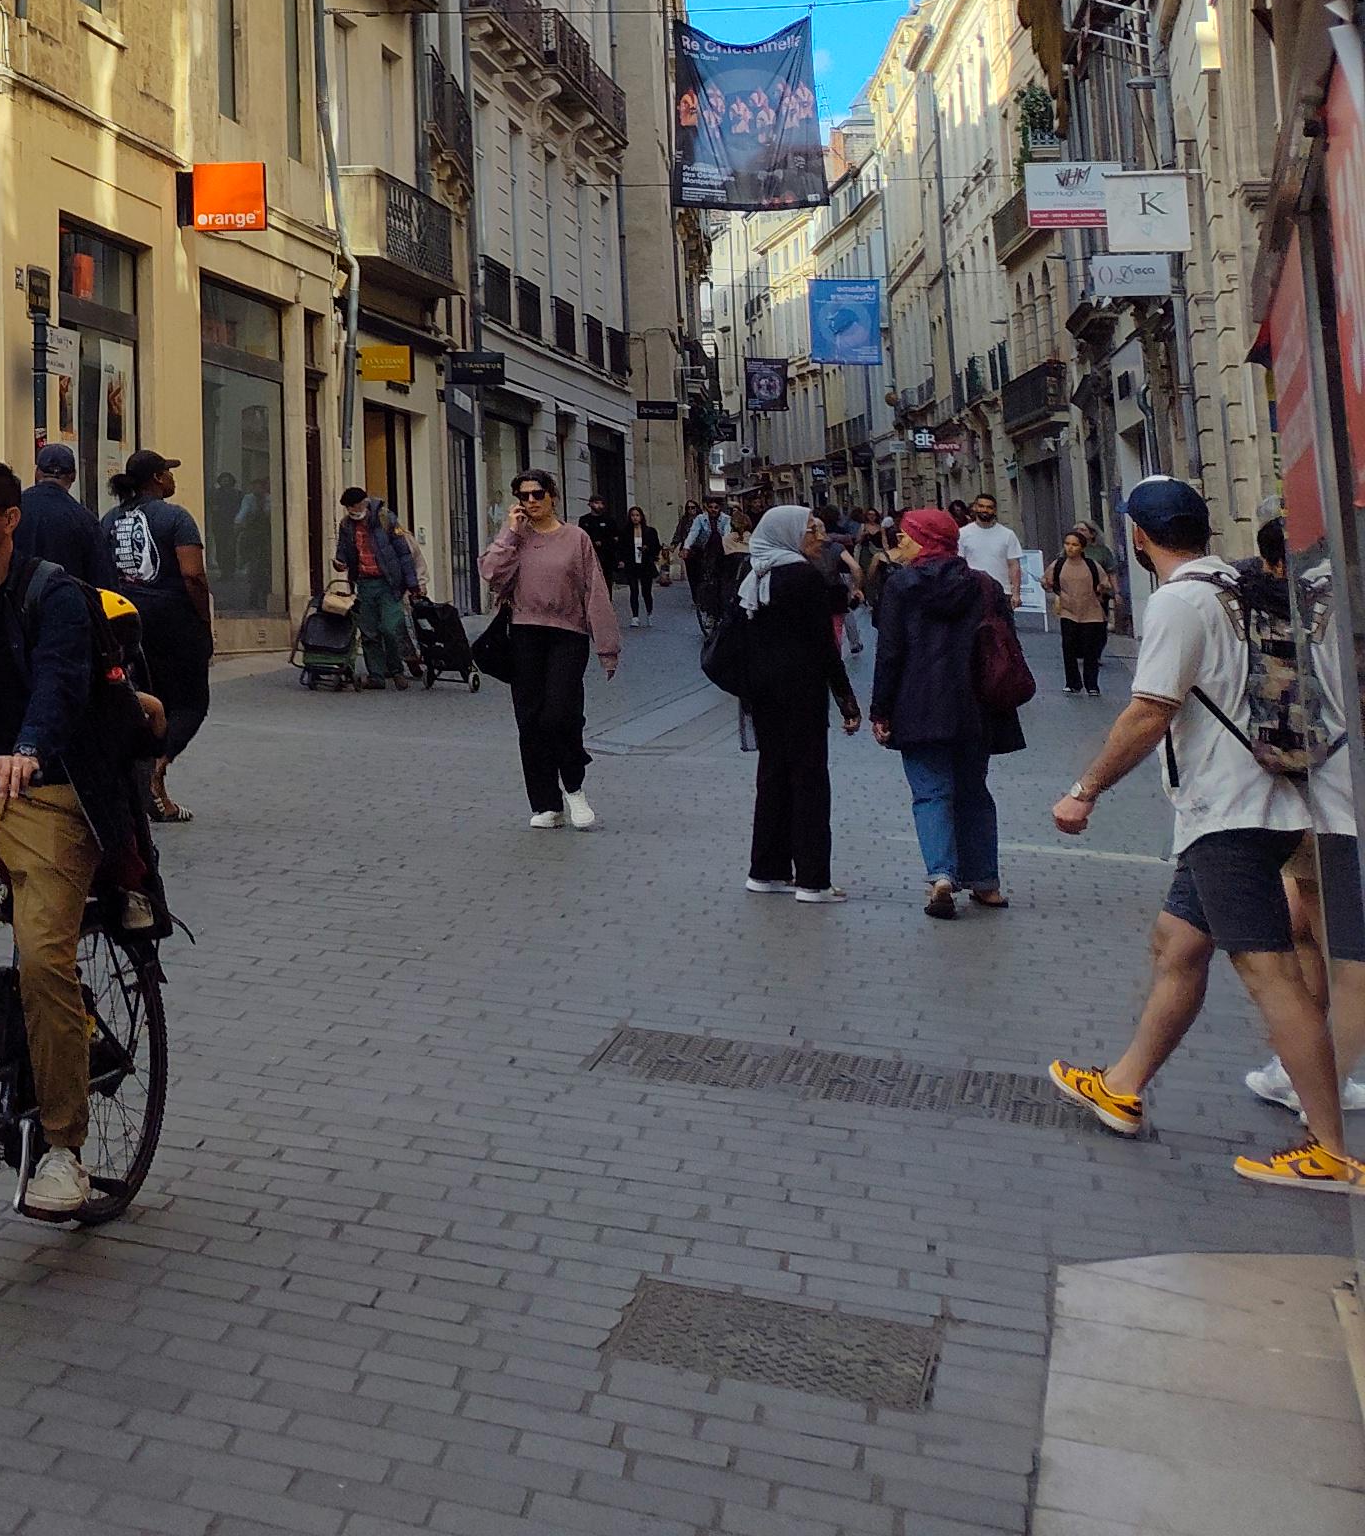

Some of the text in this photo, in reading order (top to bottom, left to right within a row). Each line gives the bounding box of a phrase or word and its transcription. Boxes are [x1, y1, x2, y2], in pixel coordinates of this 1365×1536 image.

[681, 35, 700, 51] Re
[1137, 191, 1169, 216] K
[197, 212, 256, 228] orange
